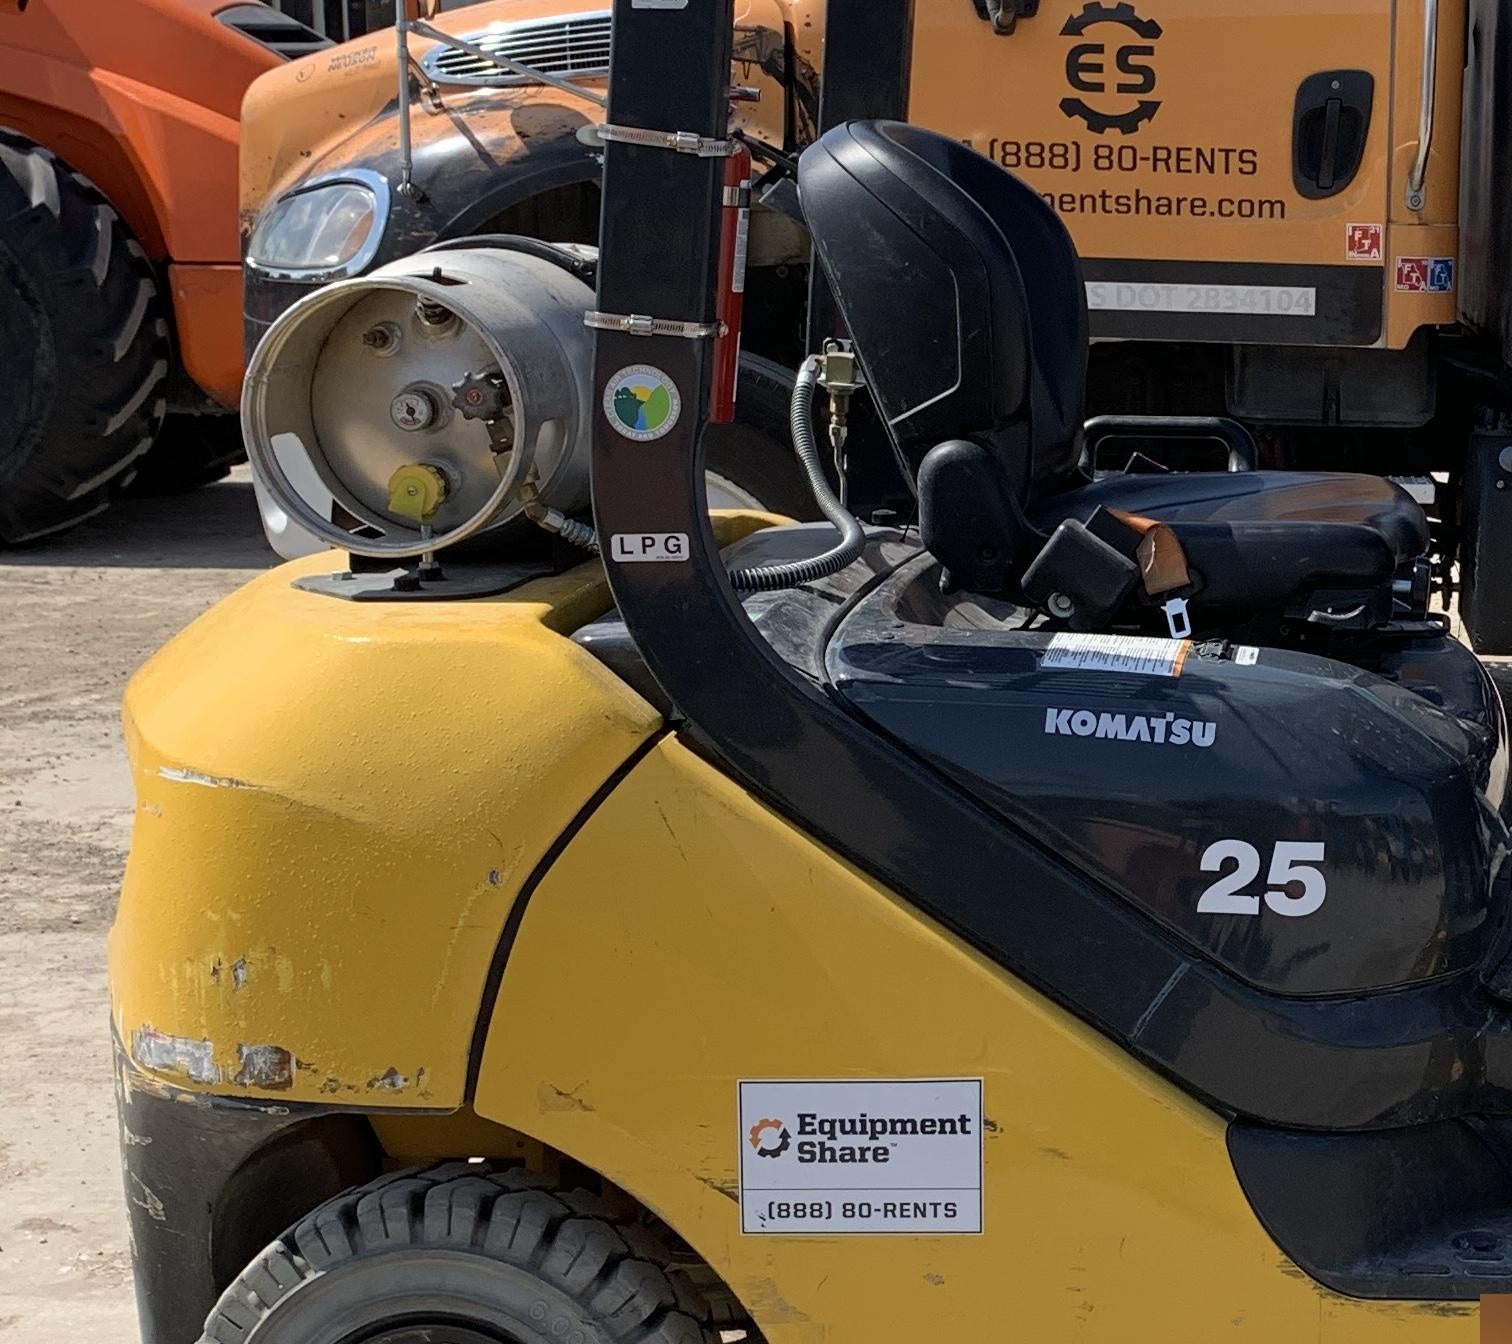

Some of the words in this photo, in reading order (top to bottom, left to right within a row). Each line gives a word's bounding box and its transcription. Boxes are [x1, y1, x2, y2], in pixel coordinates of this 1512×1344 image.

[1066, 43, 1156, 94] ES
[989, 138, 1081, 172] (888)
[1094, 144, 1258, 175] 80-RENTS
[1116, 285, 1178, 308] DOT
[1187, 287, 1312, 313] 2834104
[1045, 707, 1217, 747] KOMATSU
[1197, 839, 1327, 917] 25
[797, 1113, 971, 1141] Equipment
[768, 1201, 832, 1220] (888)
[842, 1202, 958, 1219] 80-RENTS
